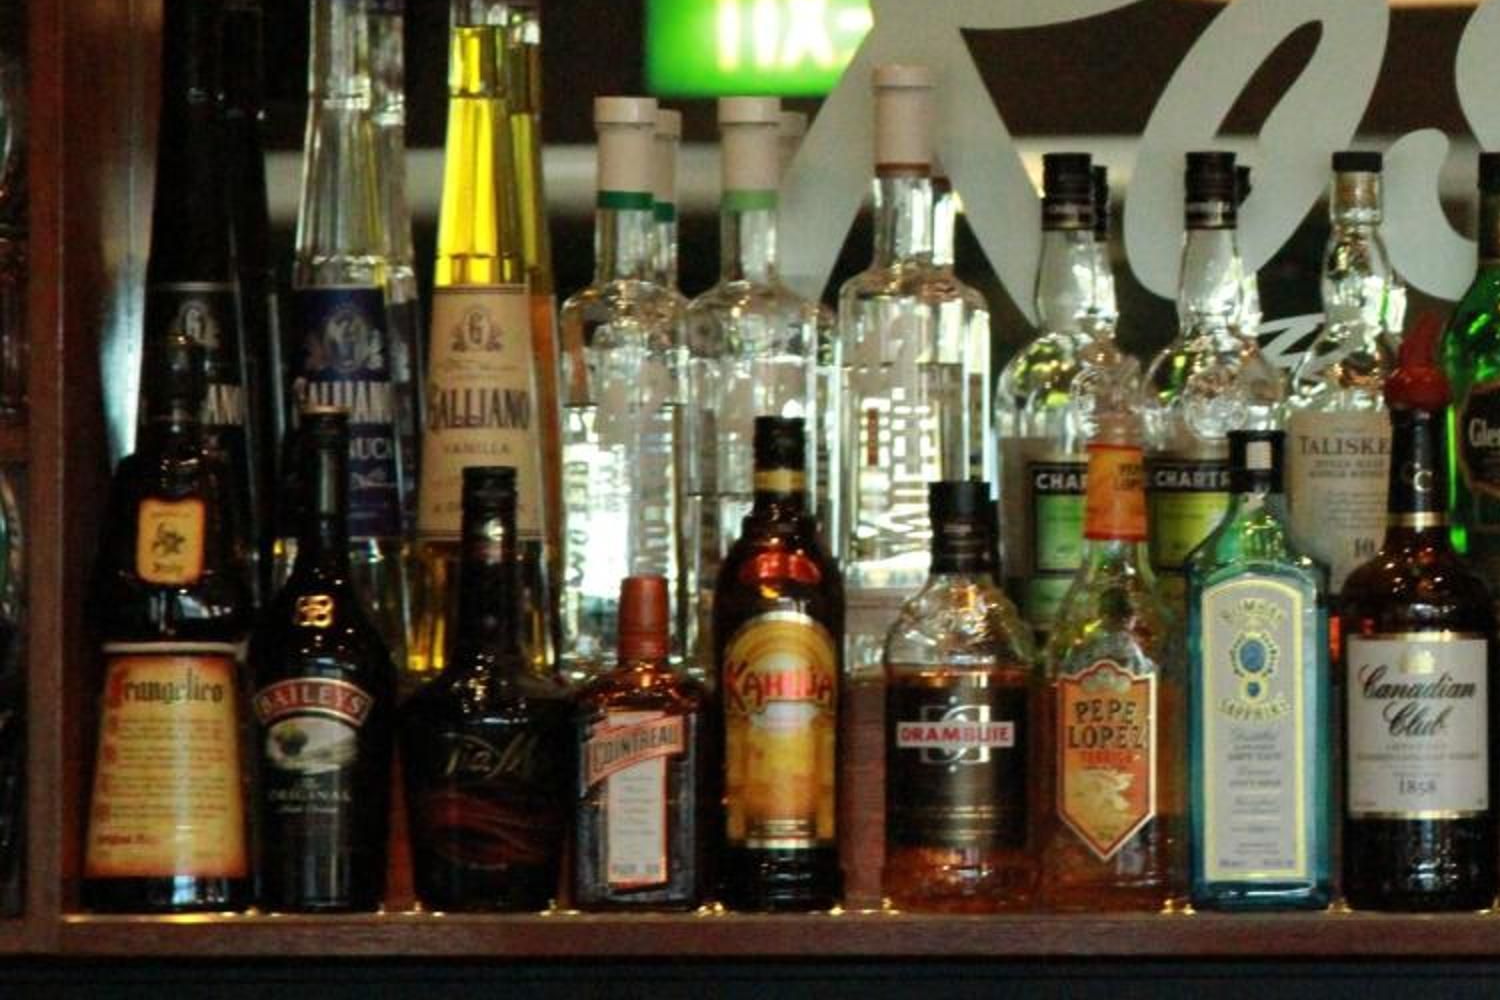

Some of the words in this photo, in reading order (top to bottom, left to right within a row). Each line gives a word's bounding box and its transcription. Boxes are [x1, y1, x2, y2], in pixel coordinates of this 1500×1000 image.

[1297, 435, 1392, 456] TALISKE
[1358, 663, 1478, 699] Canadian
[261, 683, 366, 715] BAILEYS
[1074, 698, 1137, 725] PEPE
[1382, 700, 1455, 737] Club
[900, 725, 1010, 743] DRAMBUIE
[1067, 724, 1146, 750] LOPEZ
